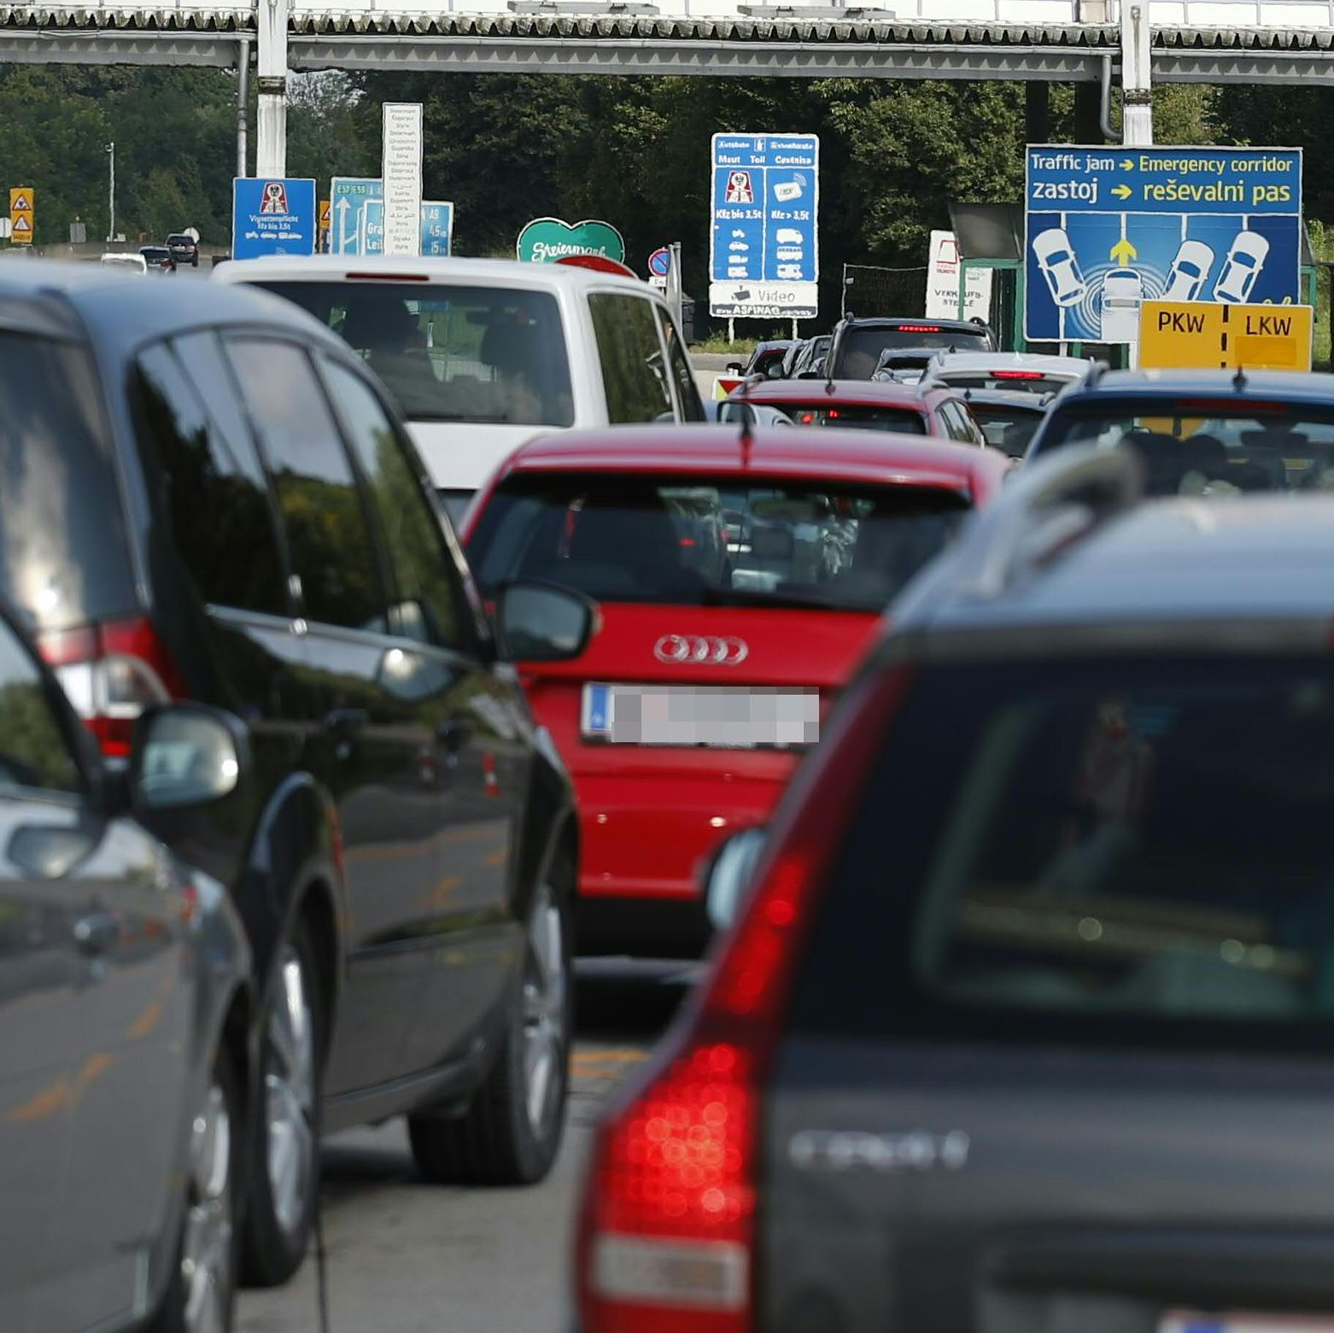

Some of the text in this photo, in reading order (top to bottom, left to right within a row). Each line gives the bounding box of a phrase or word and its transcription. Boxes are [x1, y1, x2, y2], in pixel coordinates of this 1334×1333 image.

[718, 155, 741, 164] Maut
[1031, 154, 1292, 174] Traffic jam Emergency corridor
[1033, 178, 1290, 205] zastoj reševalni pas
[368, 222, 383, 235] Gra
[758, 290, 795, 302] Video
[1158, 312, 1204, 333] PKW
[1246, 315, 1291, 335] LKW
